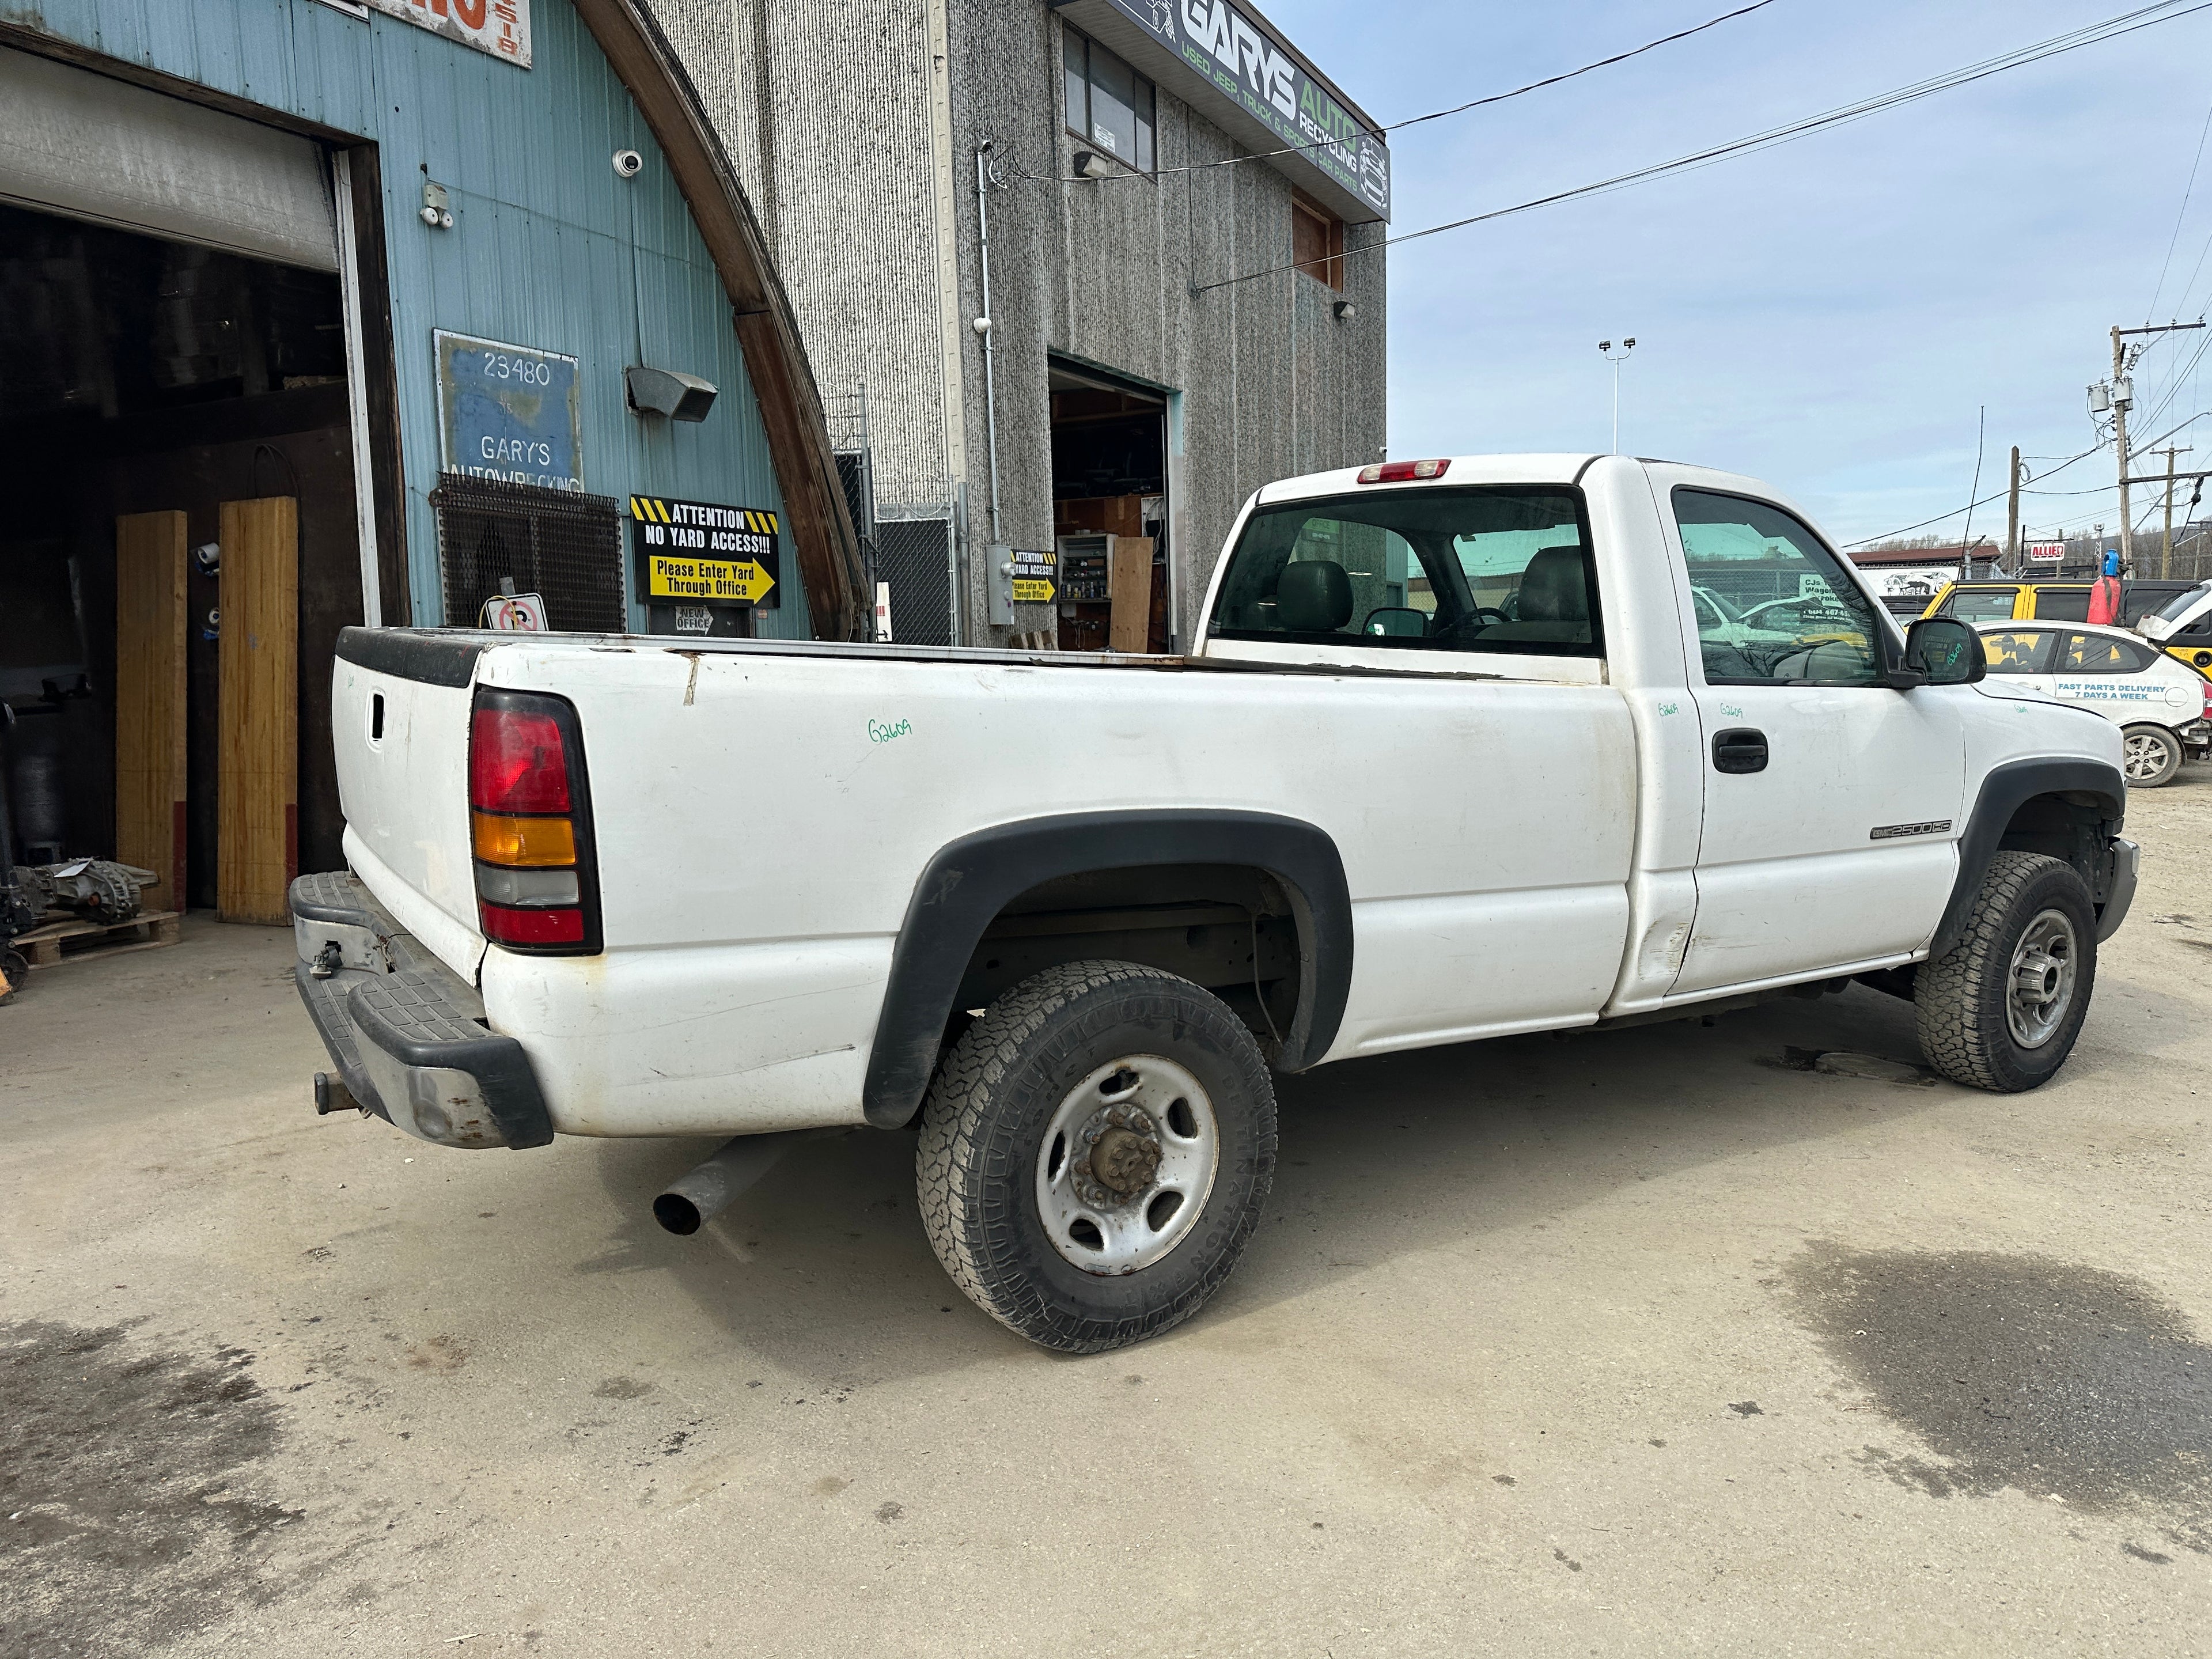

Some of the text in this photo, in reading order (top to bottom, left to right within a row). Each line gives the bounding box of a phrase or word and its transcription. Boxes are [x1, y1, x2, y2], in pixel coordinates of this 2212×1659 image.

[1181, 0, 1296, 120] GARYS
[1182, 40, 1357, 192] USED JEEP, TRUCK & SPORTS CAR PARTS
[1300, 79, 1356, 153] AUTO
[1300, 111, 1357, 173] RECYCLING
[484, 352, 550, 385] 23480
[481, 435, 550, 465] GARY'S
[672, 503, 745, 529] ATTENTION
[645, 525, 770, 554] NO YARD ACCESS!!!
[1016, 551, 1043, 563] ATTENTION
[657, 560, 755, 581] Please Enter Yard
[1016, 564, 1029, 575] YARD
[666, 577, 747, 596] Through Office
[1013, 582, 1025, 590] lease
[1026, 581, 1037, 590] Enter
[1014, 590, 1045, 600] Through Office
[681, 608, 704, 618] NEW
[2118, 684, 2166, 693] DELIVERY
